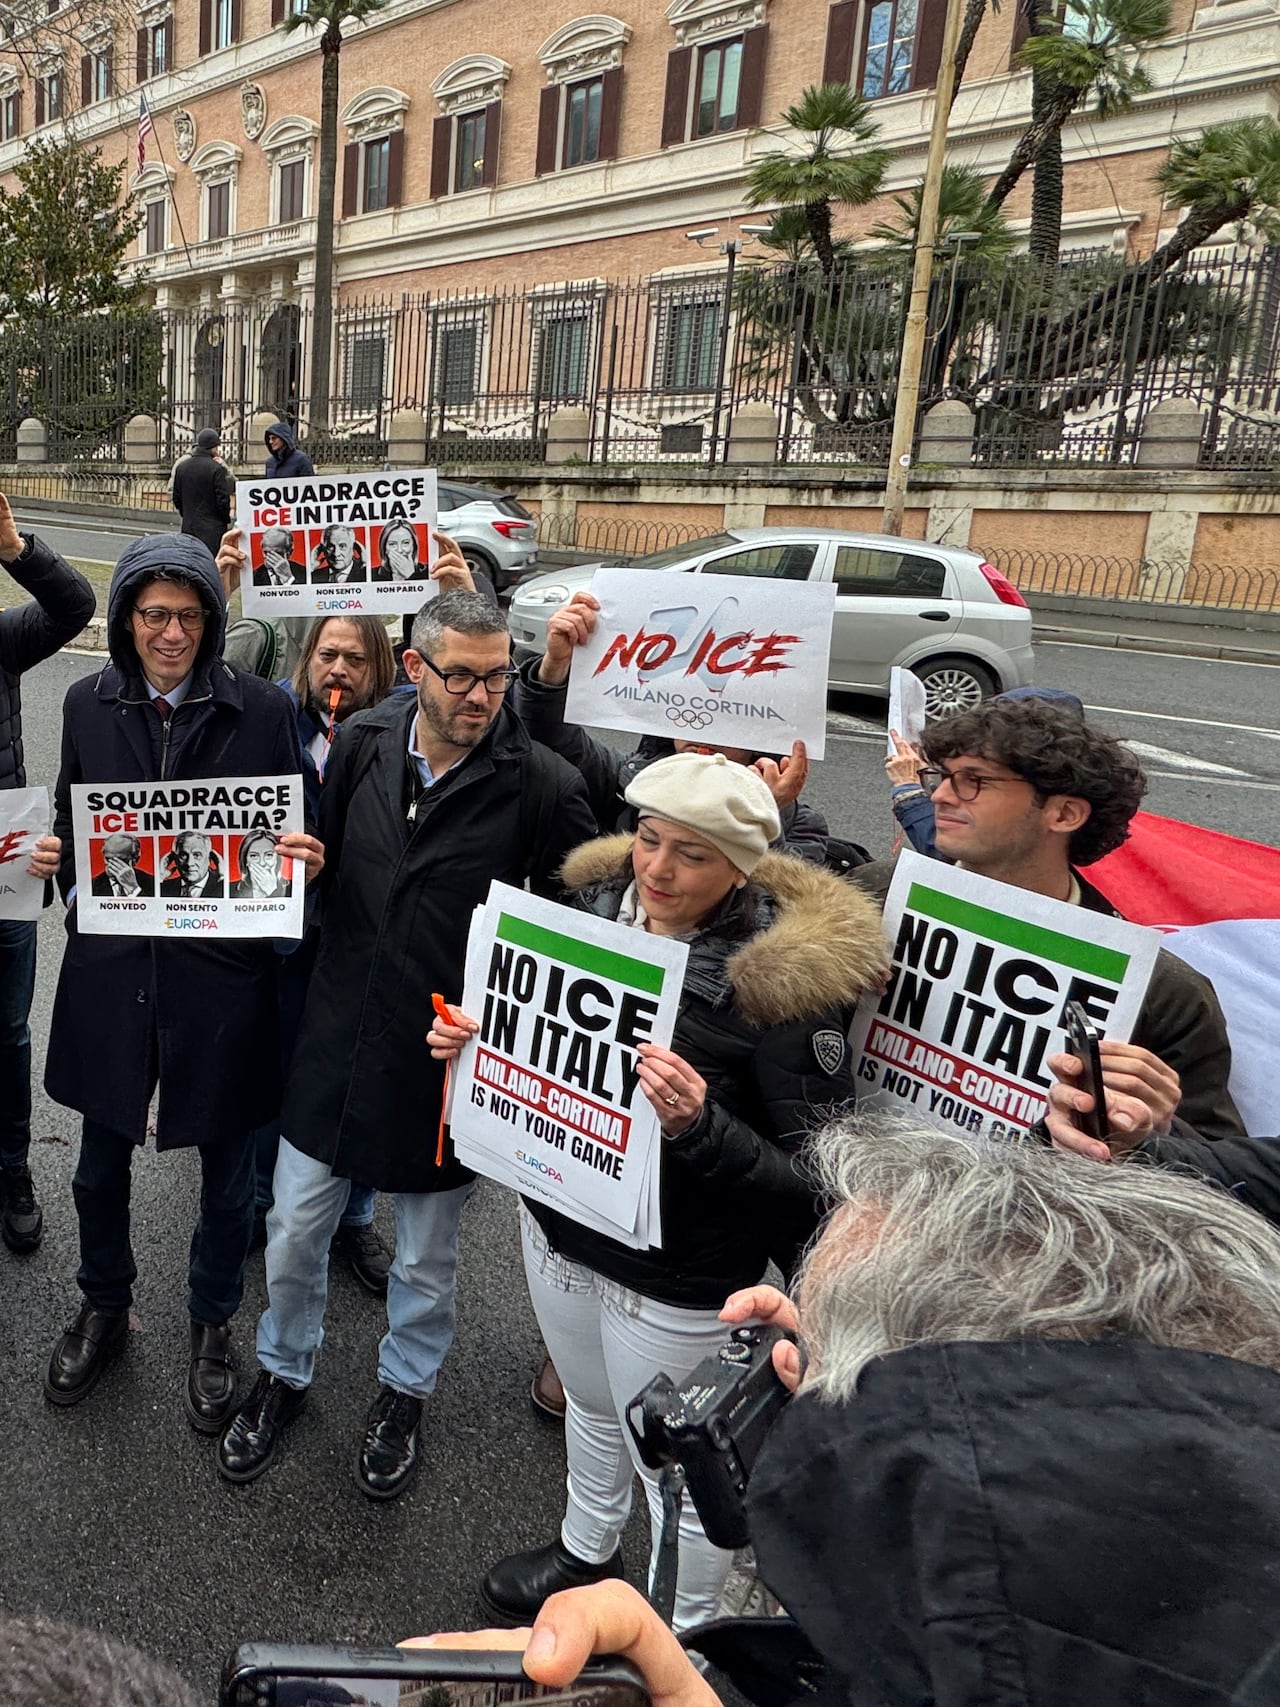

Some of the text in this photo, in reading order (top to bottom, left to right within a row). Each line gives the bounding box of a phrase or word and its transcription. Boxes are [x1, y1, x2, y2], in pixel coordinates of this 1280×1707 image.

[249, 477, 425, 507] SQUADRACCE
[253, 498, 421, 527] ICE IN ITALIA?
[278, 589, 300, 597] VEDO
[336, 587, 362, 595] SENTO
[592, 625, 805, 680] NO ICE
[602, 685, 785, 721] MILANO CORTINA
[87, 785, 290, 812] SQUADRACCE
[93, 808, 287, 833] ICE IN ITALIA?
[100, 902, 147, 911] NON VEDO
[166, 904, 218, 912] NON SENTO
[234, 904, 285, 912] NON PARLO
[893, 913, 1118, 1041] NO ICE
[487, 943, 659, 1049] NO ICE
[877, 965, 1070, 1088] IN ITAL
[480, 994, 642, 1110] IN ITALY
[871, 1027, 1047, 1123] MILANO-CORTIN
[478, 1053, 623, 1142] MILANO-CORTINA
[857, 1055, 879, 1082] IS
[881, 1068, 924, 1104] NOT
[928, 1088, 984, 1136] YOUR
[471, 1084, 624, 1180] IS NOT YOUR GAME
